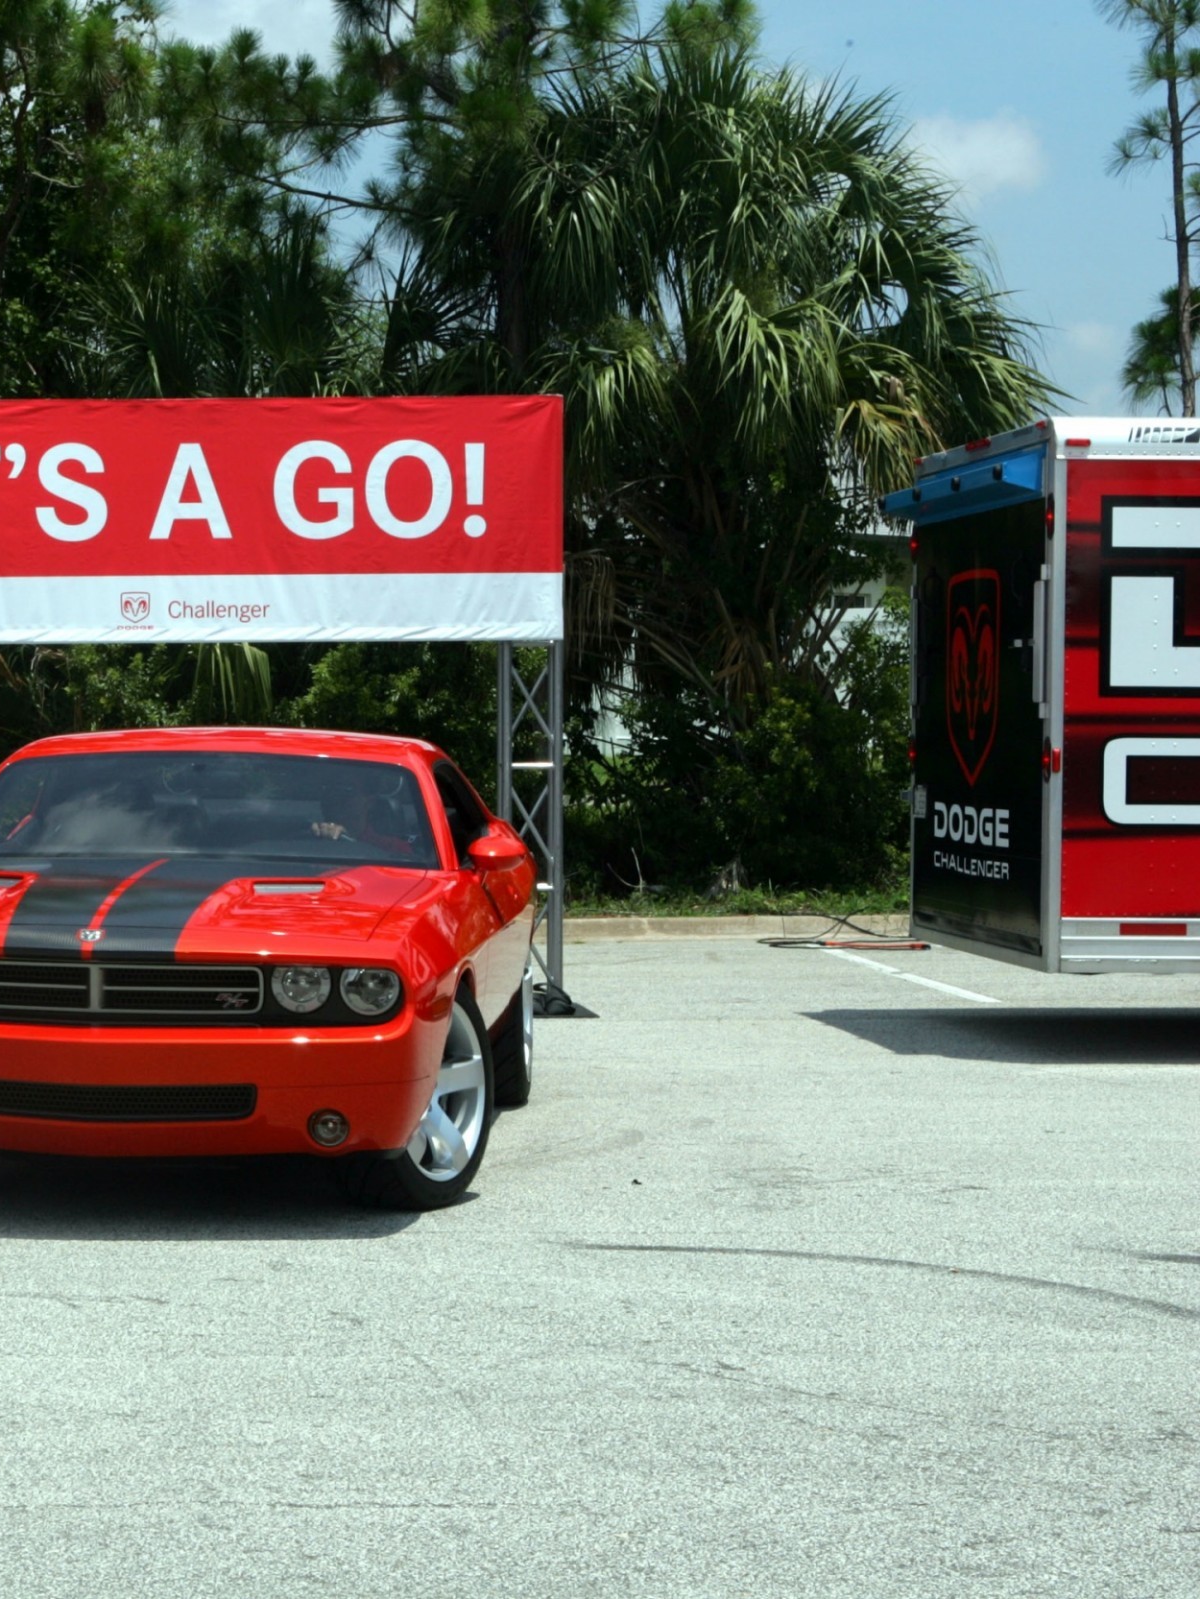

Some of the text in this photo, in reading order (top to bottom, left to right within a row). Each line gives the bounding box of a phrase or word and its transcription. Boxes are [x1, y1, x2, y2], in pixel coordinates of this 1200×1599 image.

[149, 443, 233, 539] A
[273, 439, 487, 540] GO!
[168, 600, 270, 623] Challenger
[933, 801, 1010, 848] DODGE
[933, 850, 1010, 880] CHALLENGER
